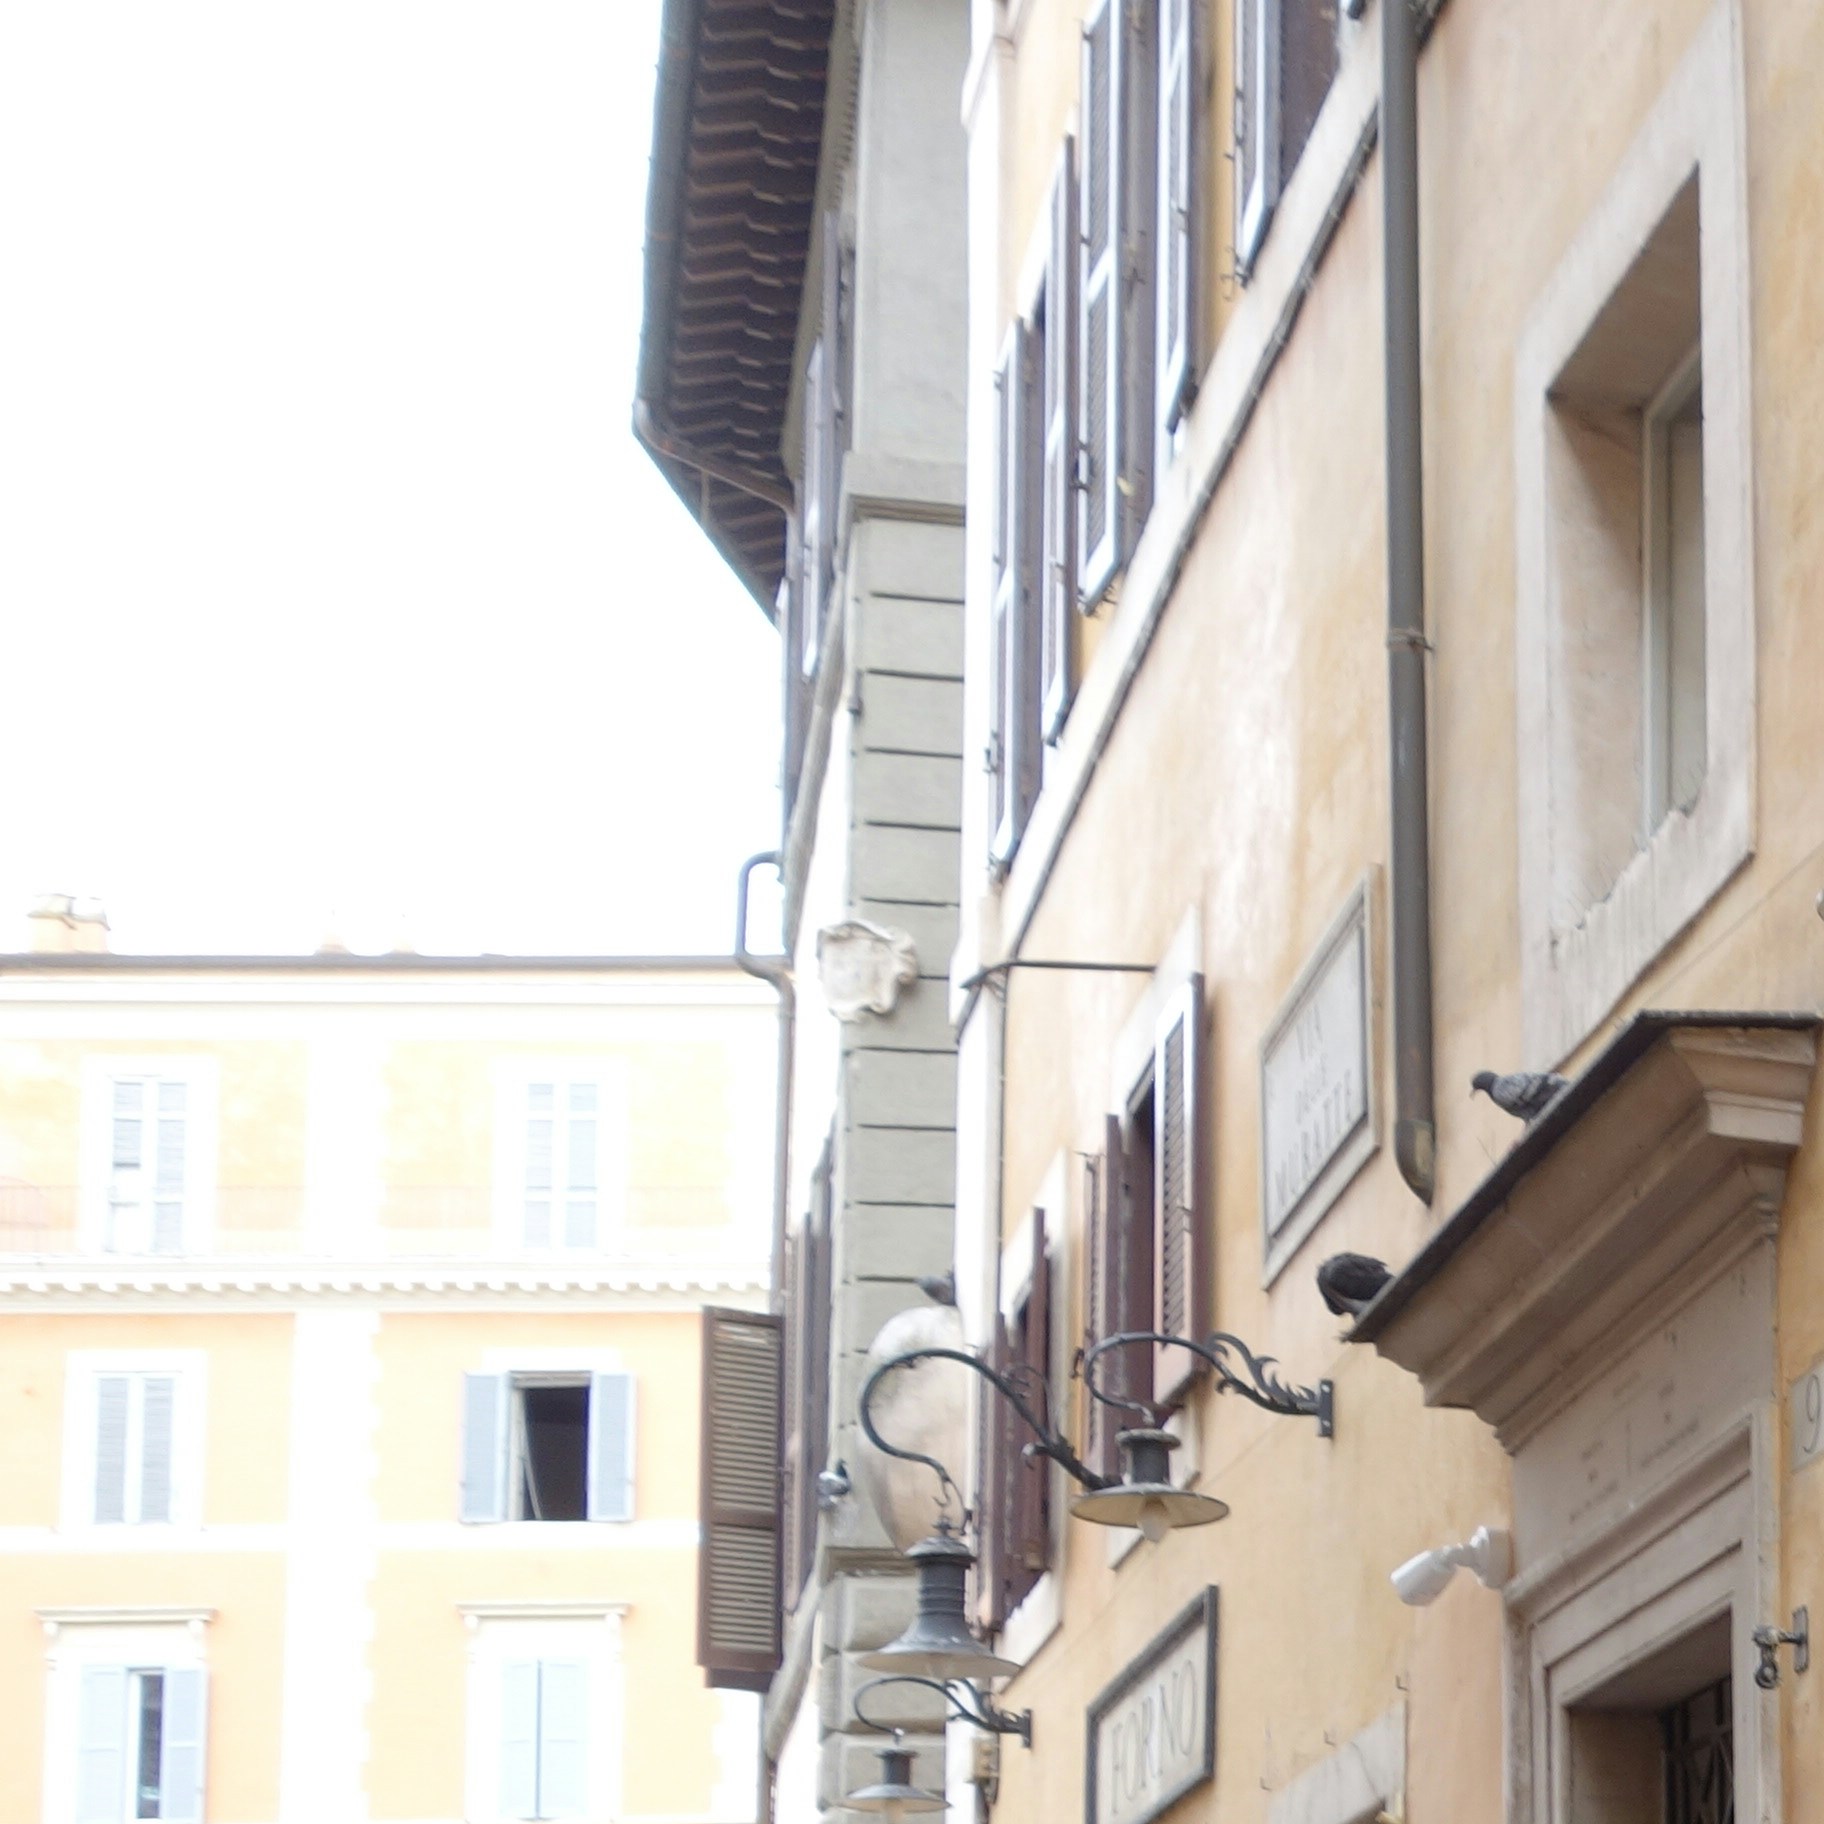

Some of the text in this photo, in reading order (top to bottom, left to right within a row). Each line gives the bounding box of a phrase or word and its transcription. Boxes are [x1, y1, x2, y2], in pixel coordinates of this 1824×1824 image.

[1297, 1003, 1324, 1062] VIA
[1802, 1374, 1821, 1453] 9
[1110, 1658, 1198, 1815] FORNO
